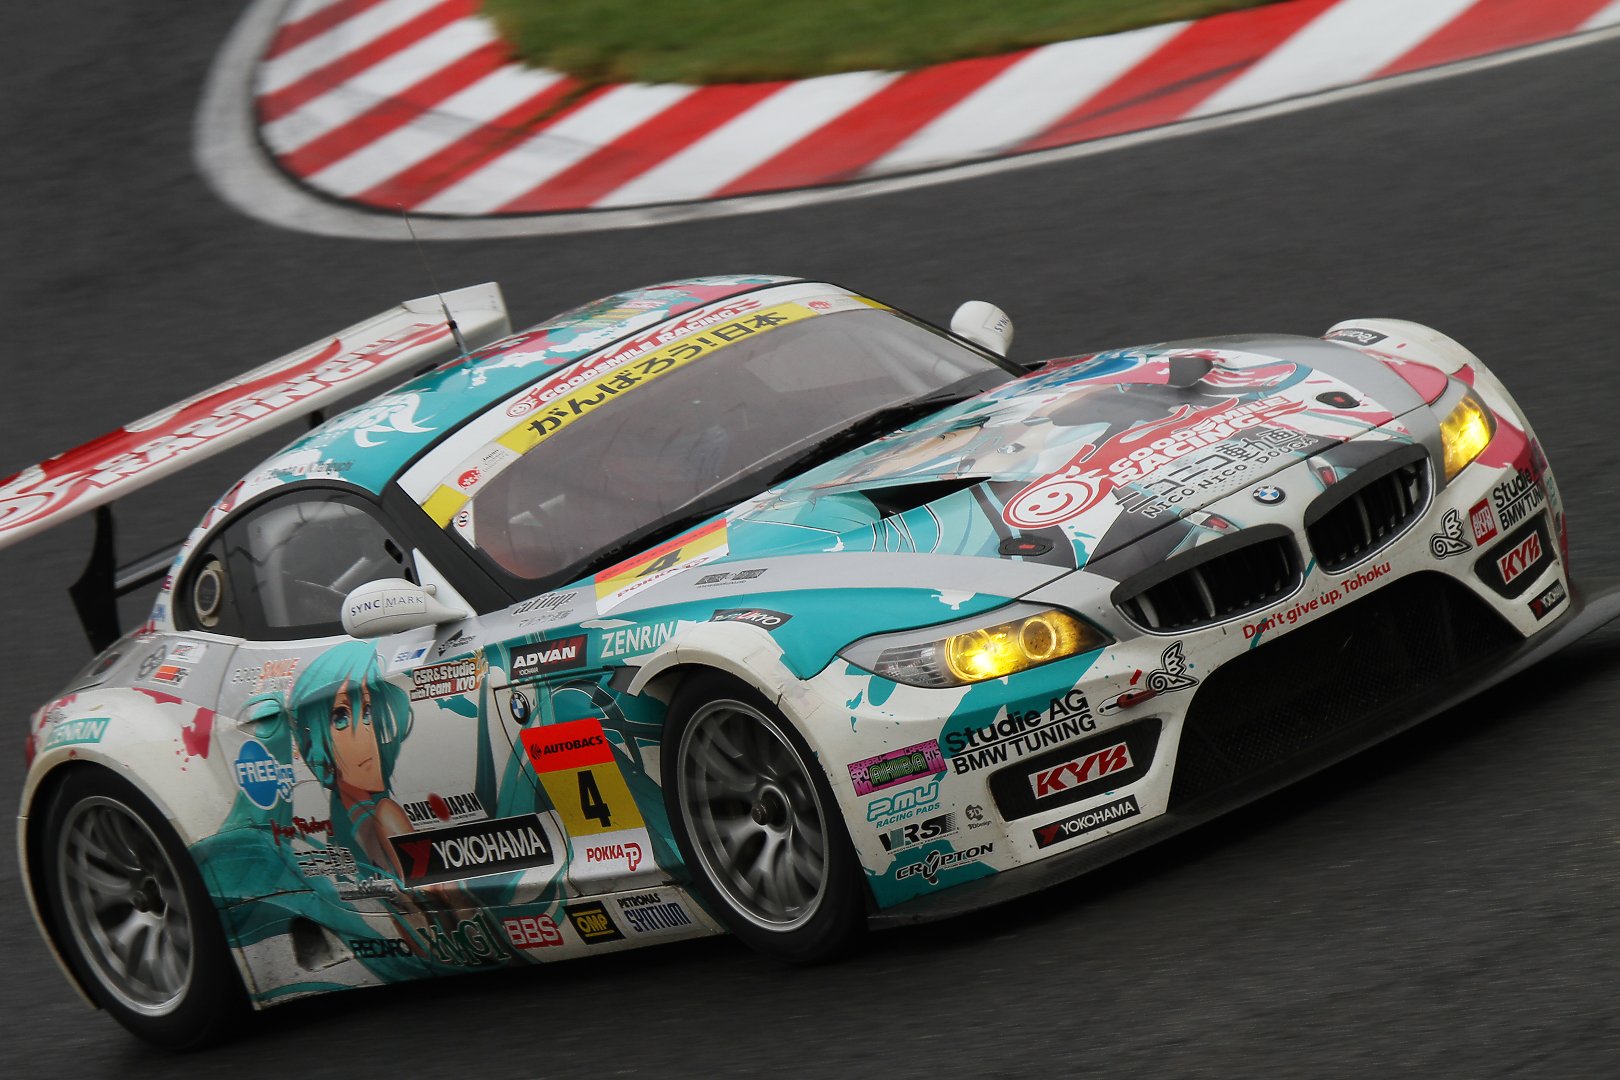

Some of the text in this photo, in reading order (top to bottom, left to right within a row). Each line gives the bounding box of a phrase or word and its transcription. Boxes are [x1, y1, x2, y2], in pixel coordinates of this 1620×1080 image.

[539, 306, 736, 402] GOODSMILE RACING
[89, 350, 378, 487] RACING
[1109, 412, 1263, 488] RACING
[1114, 428, 1303, 513] ニコニコ動画
[1143, 434, 1319, 518] NICO NICO DOUGA
[1493, 468, 1533, 509] Studie
[1499, 502, 1527, 532] BMW
[635, 547, 684, 578] 4
[1500, 533, 1542, 583] KYB
[617, 568, 678, 598] POKKA
[351, 596, 424, 617] SYNC MARK
[1242, 562, 1392, 640] Don't give up, Tohoku
[601, 620, 676, 659] ZENRIN
[413, 661, 476, 686] GSR&Studie
[512, 646, 577, 669] ADVAN
[423, 680, 451, 697] Team
[945, 689, 1090, 752] Studie AG
[543, 735, 604, 755] AUTOBACS
[952, 713, 1097, 775] BMW TUNING
[1036, 744, 1129, 798] KYB
[403, 800, 435, 822] SAVE
[444, 792, 483, 816] JAPAN
[577, 769, 612, 828] 4
[876, 802, 941, 829] RACING PADS
[1060, 800, 1136, 836] YOKOHAMA
[431, 826, 547, 869] YOKOHAMA
[586, 844, 625, 863] POKKA
[896, 842, 993, 879] CRYPTON
[617, 892, 662, 909] PETRONAS
[503, 915, 560, 946] BBS
[576, 913, 609, 934] OMP
[623, 902, 692, 933] SYNTIUM
[348, 937, 415, 959] RECARO
